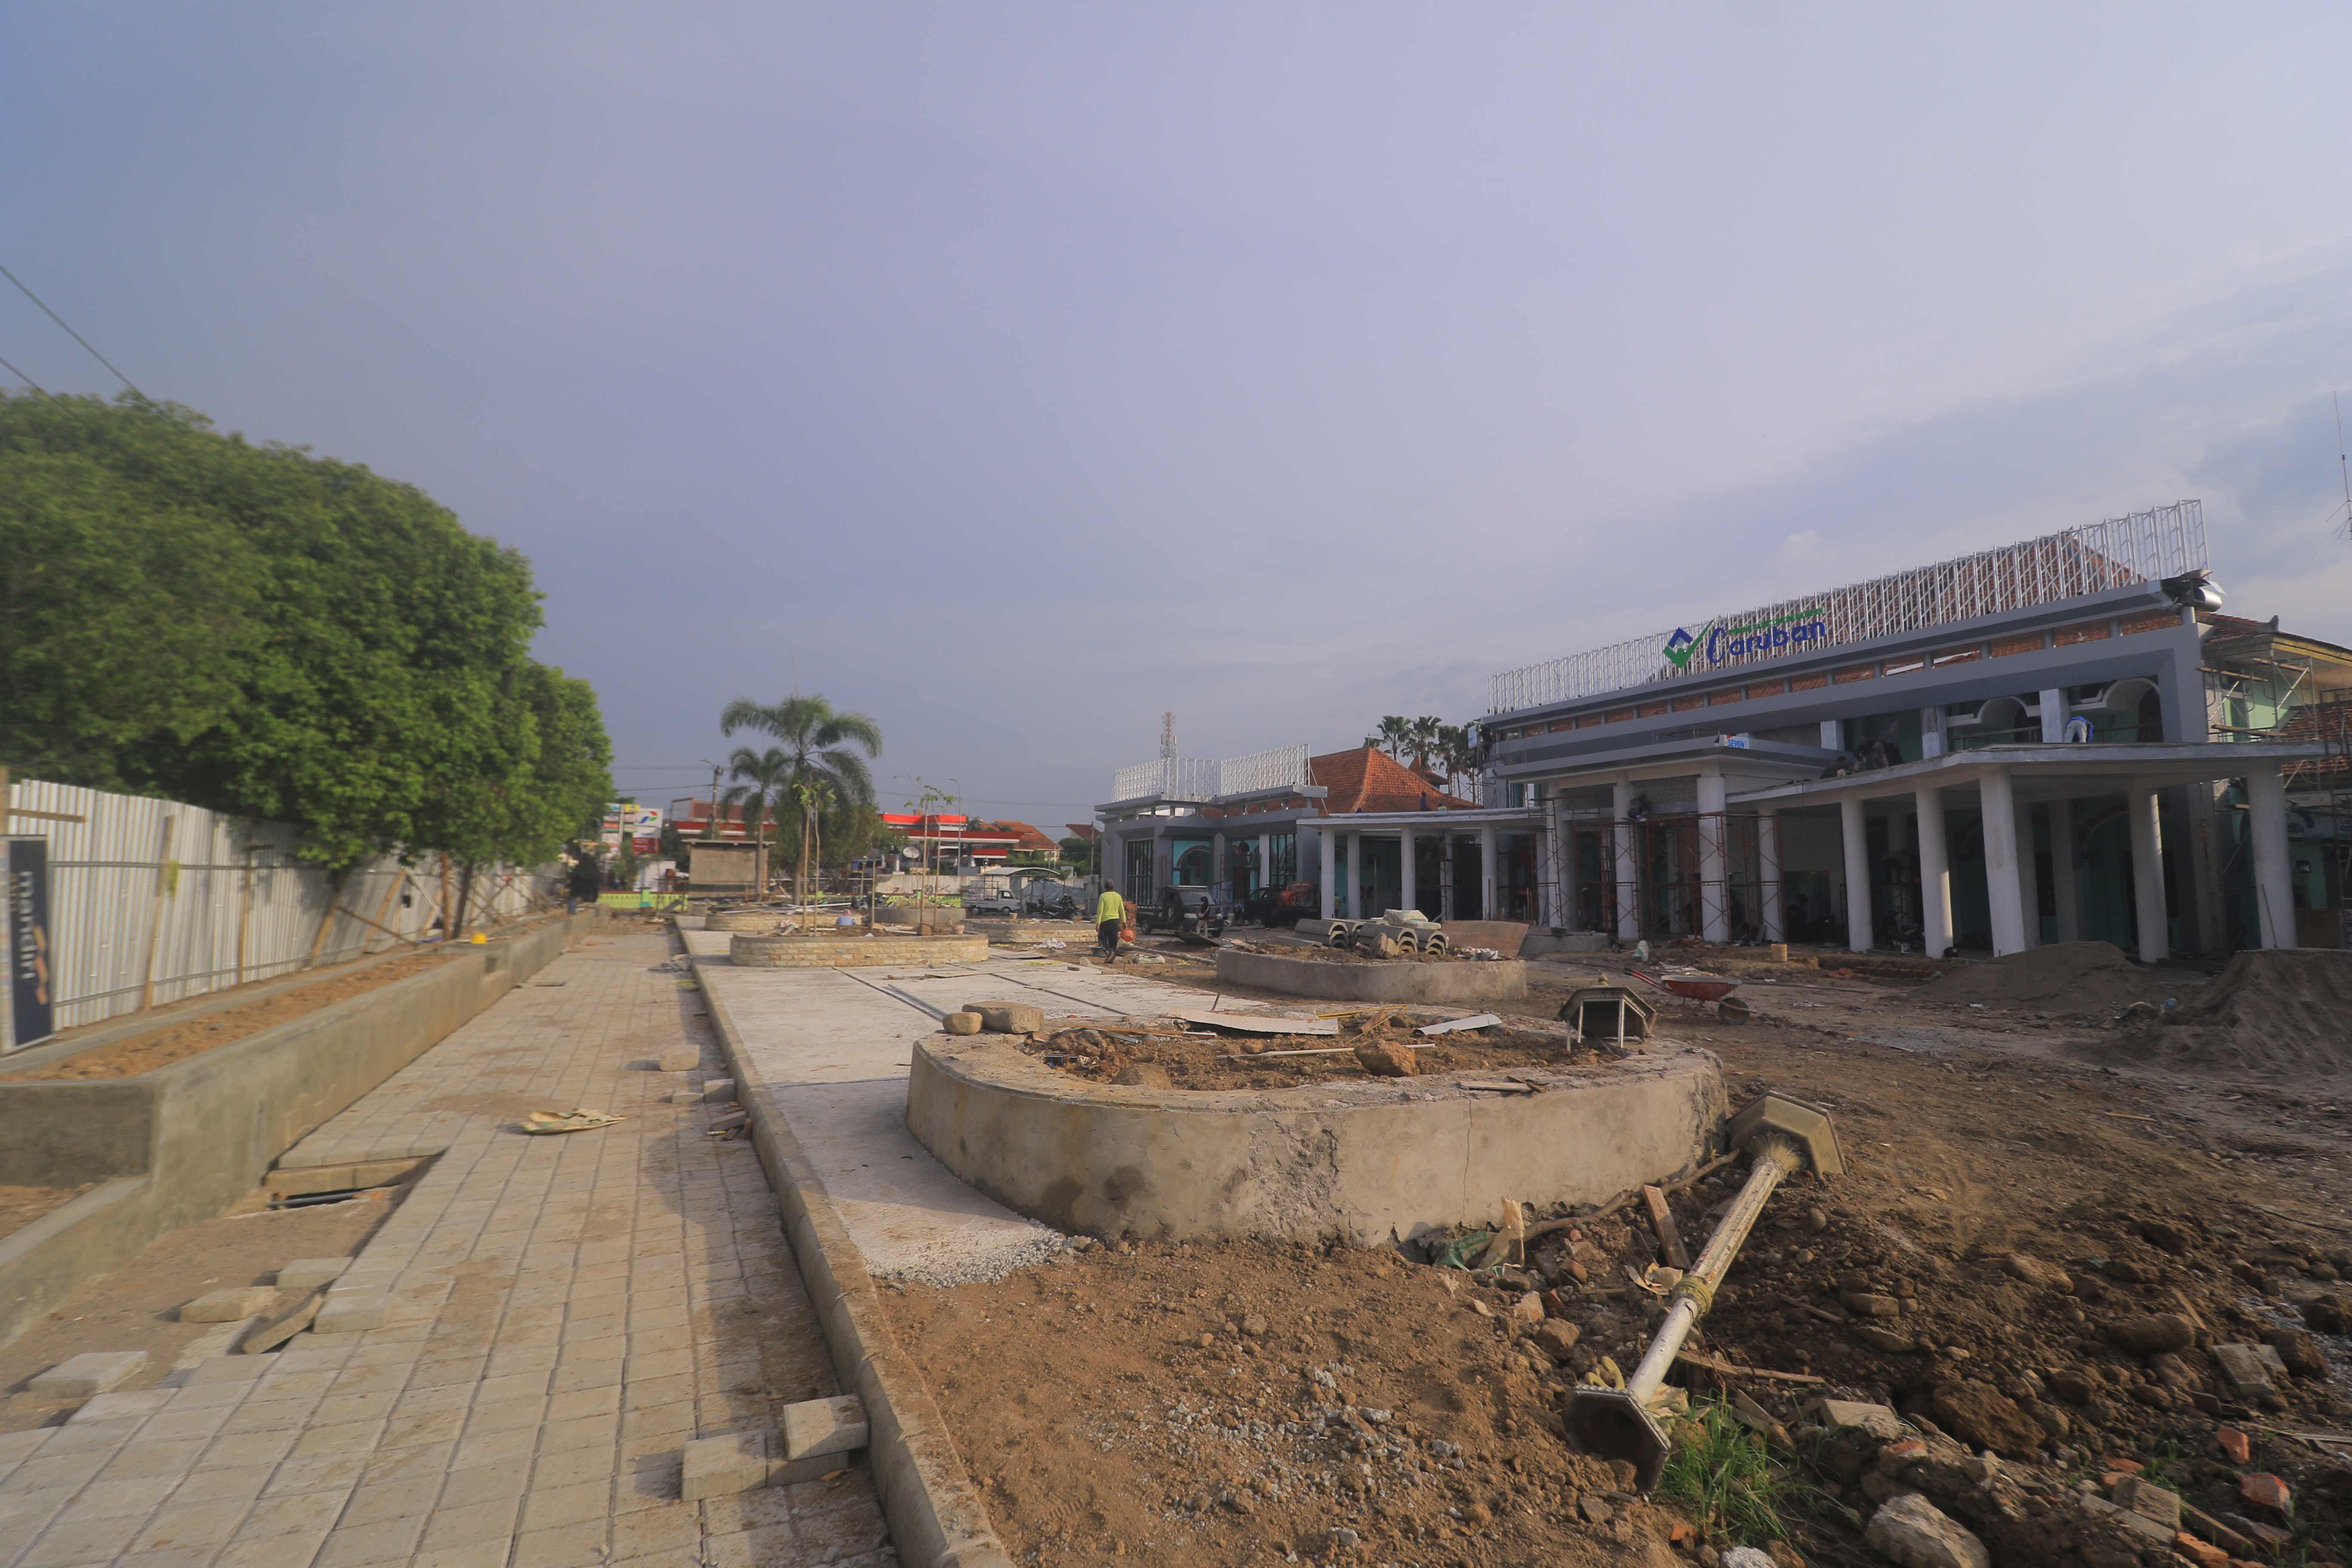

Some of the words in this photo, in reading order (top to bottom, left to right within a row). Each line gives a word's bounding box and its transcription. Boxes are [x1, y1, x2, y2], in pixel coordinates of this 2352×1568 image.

[1708, 622, 1825, 662] Caruban
[1727, 739, 1745, 748] SEVEN
[18, 870, 38, 979] mandiri
